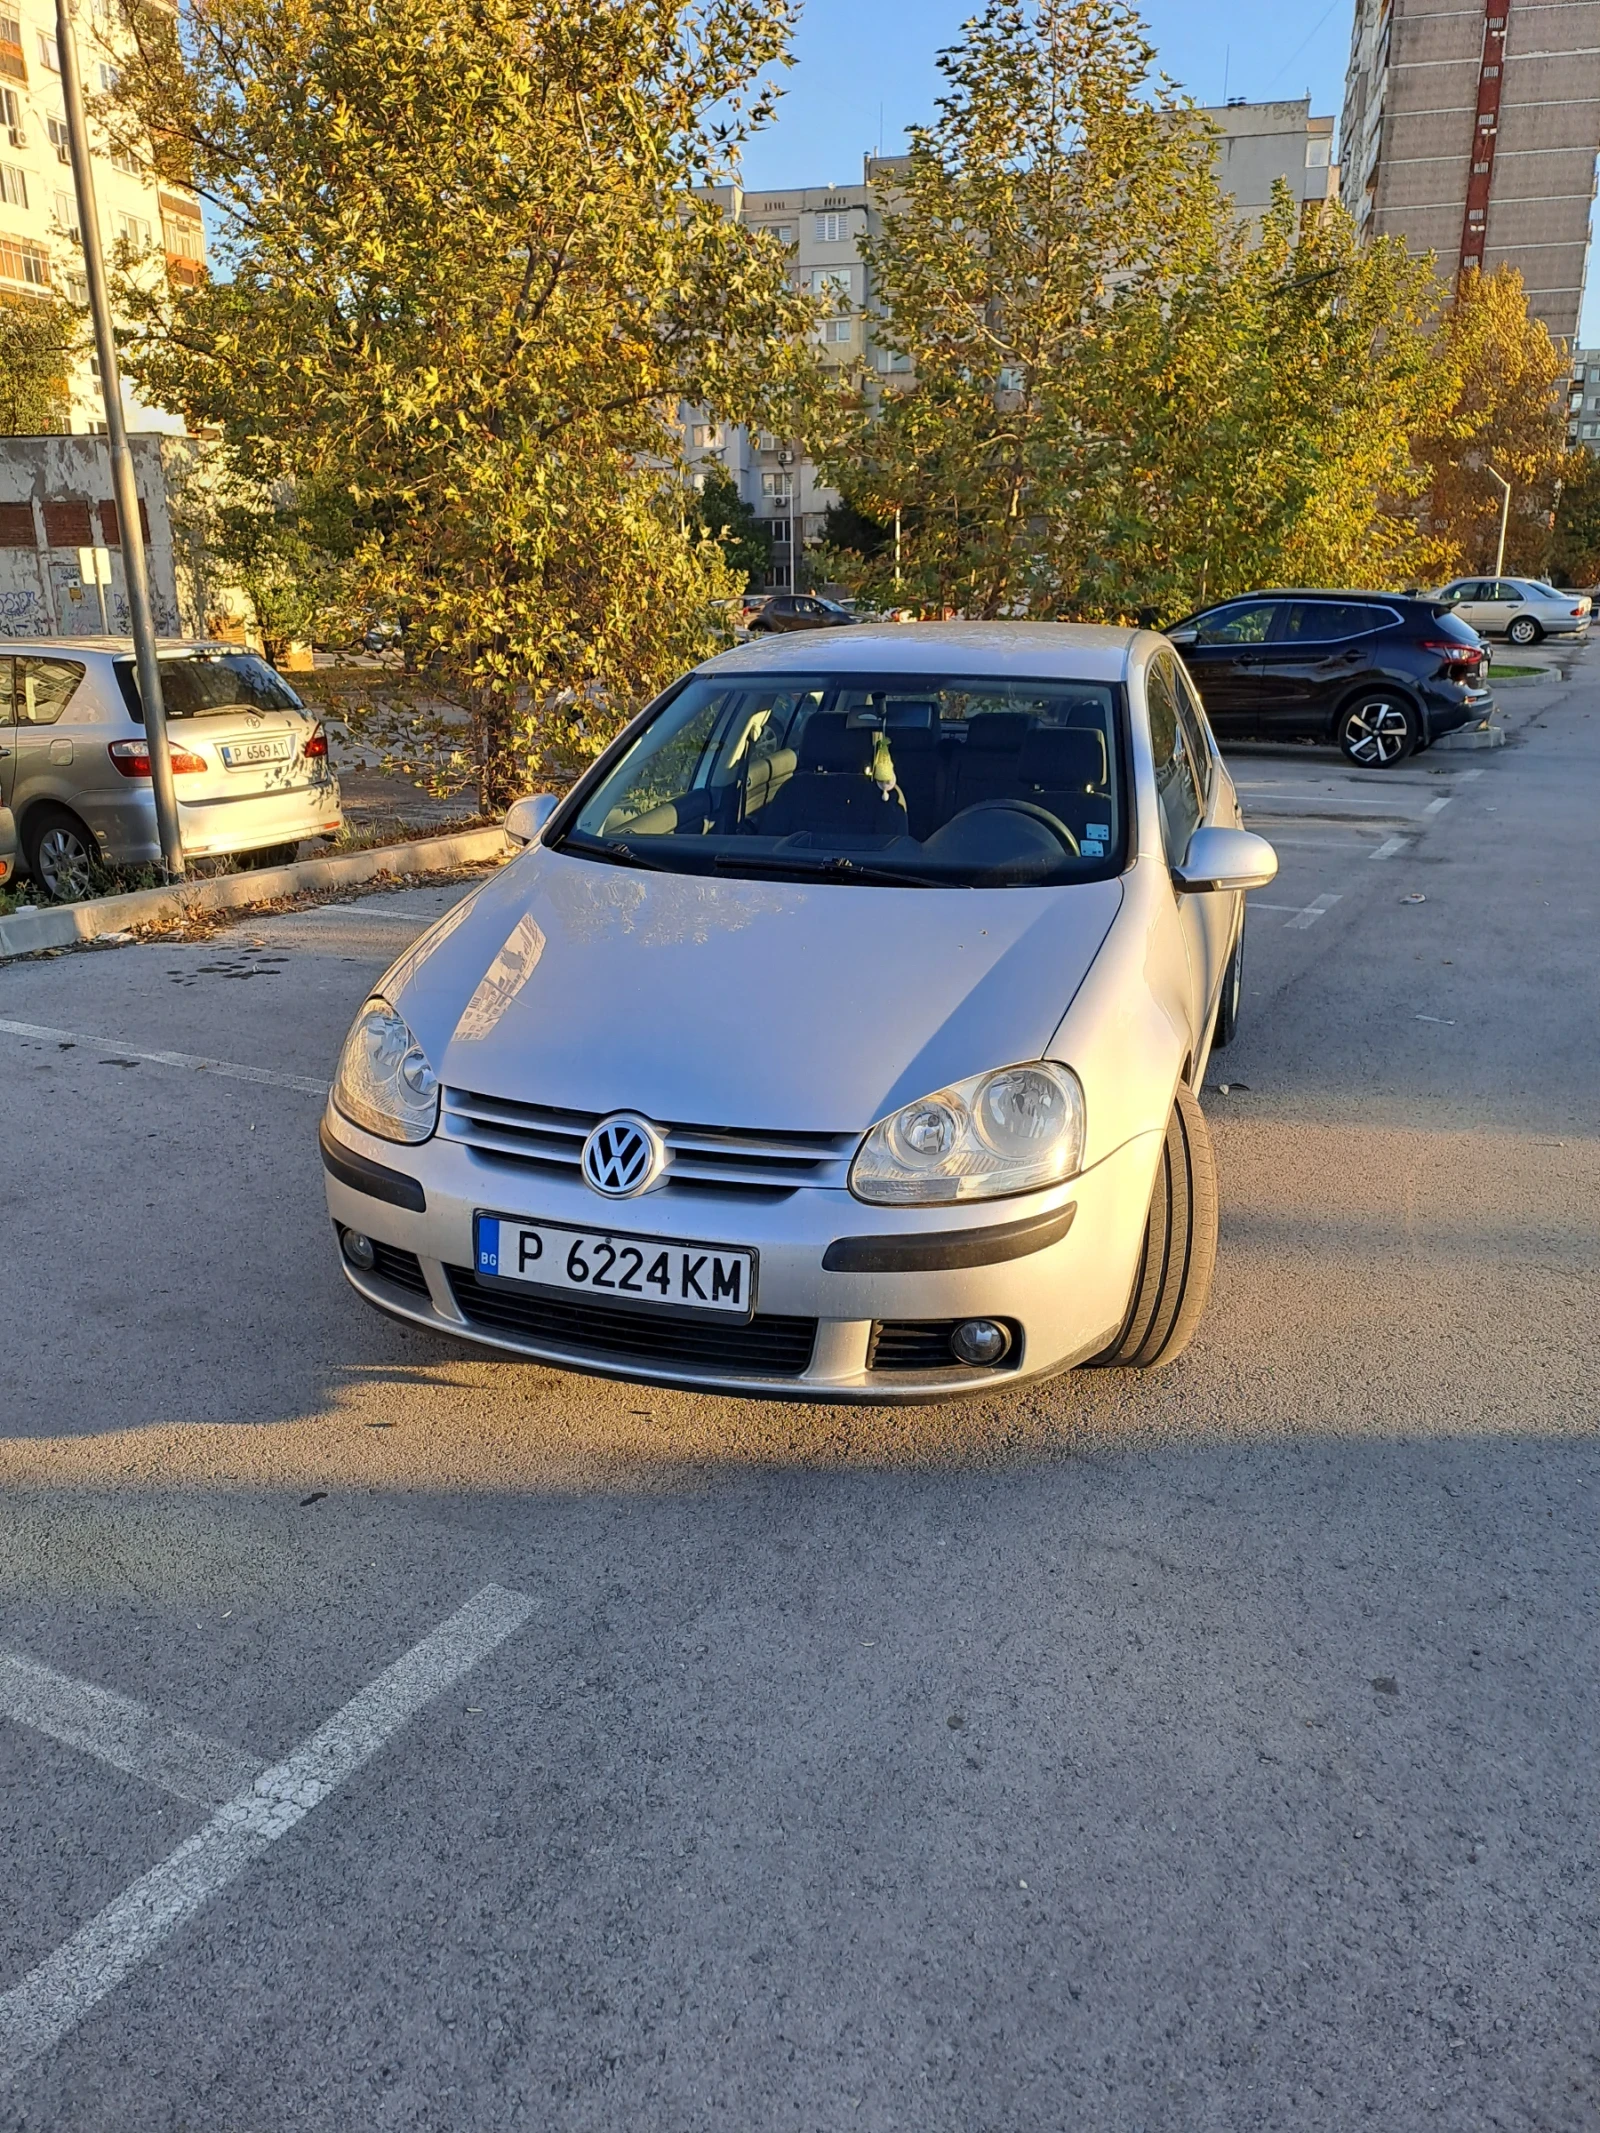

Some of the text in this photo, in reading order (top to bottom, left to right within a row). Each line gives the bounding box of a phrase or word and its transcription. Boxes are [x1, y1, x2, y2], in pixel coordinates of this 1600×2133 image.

[234, 748, 241, 761] P
[518, 1230, 543, 1273] P
[481, 1252, 497, 1266] BG
